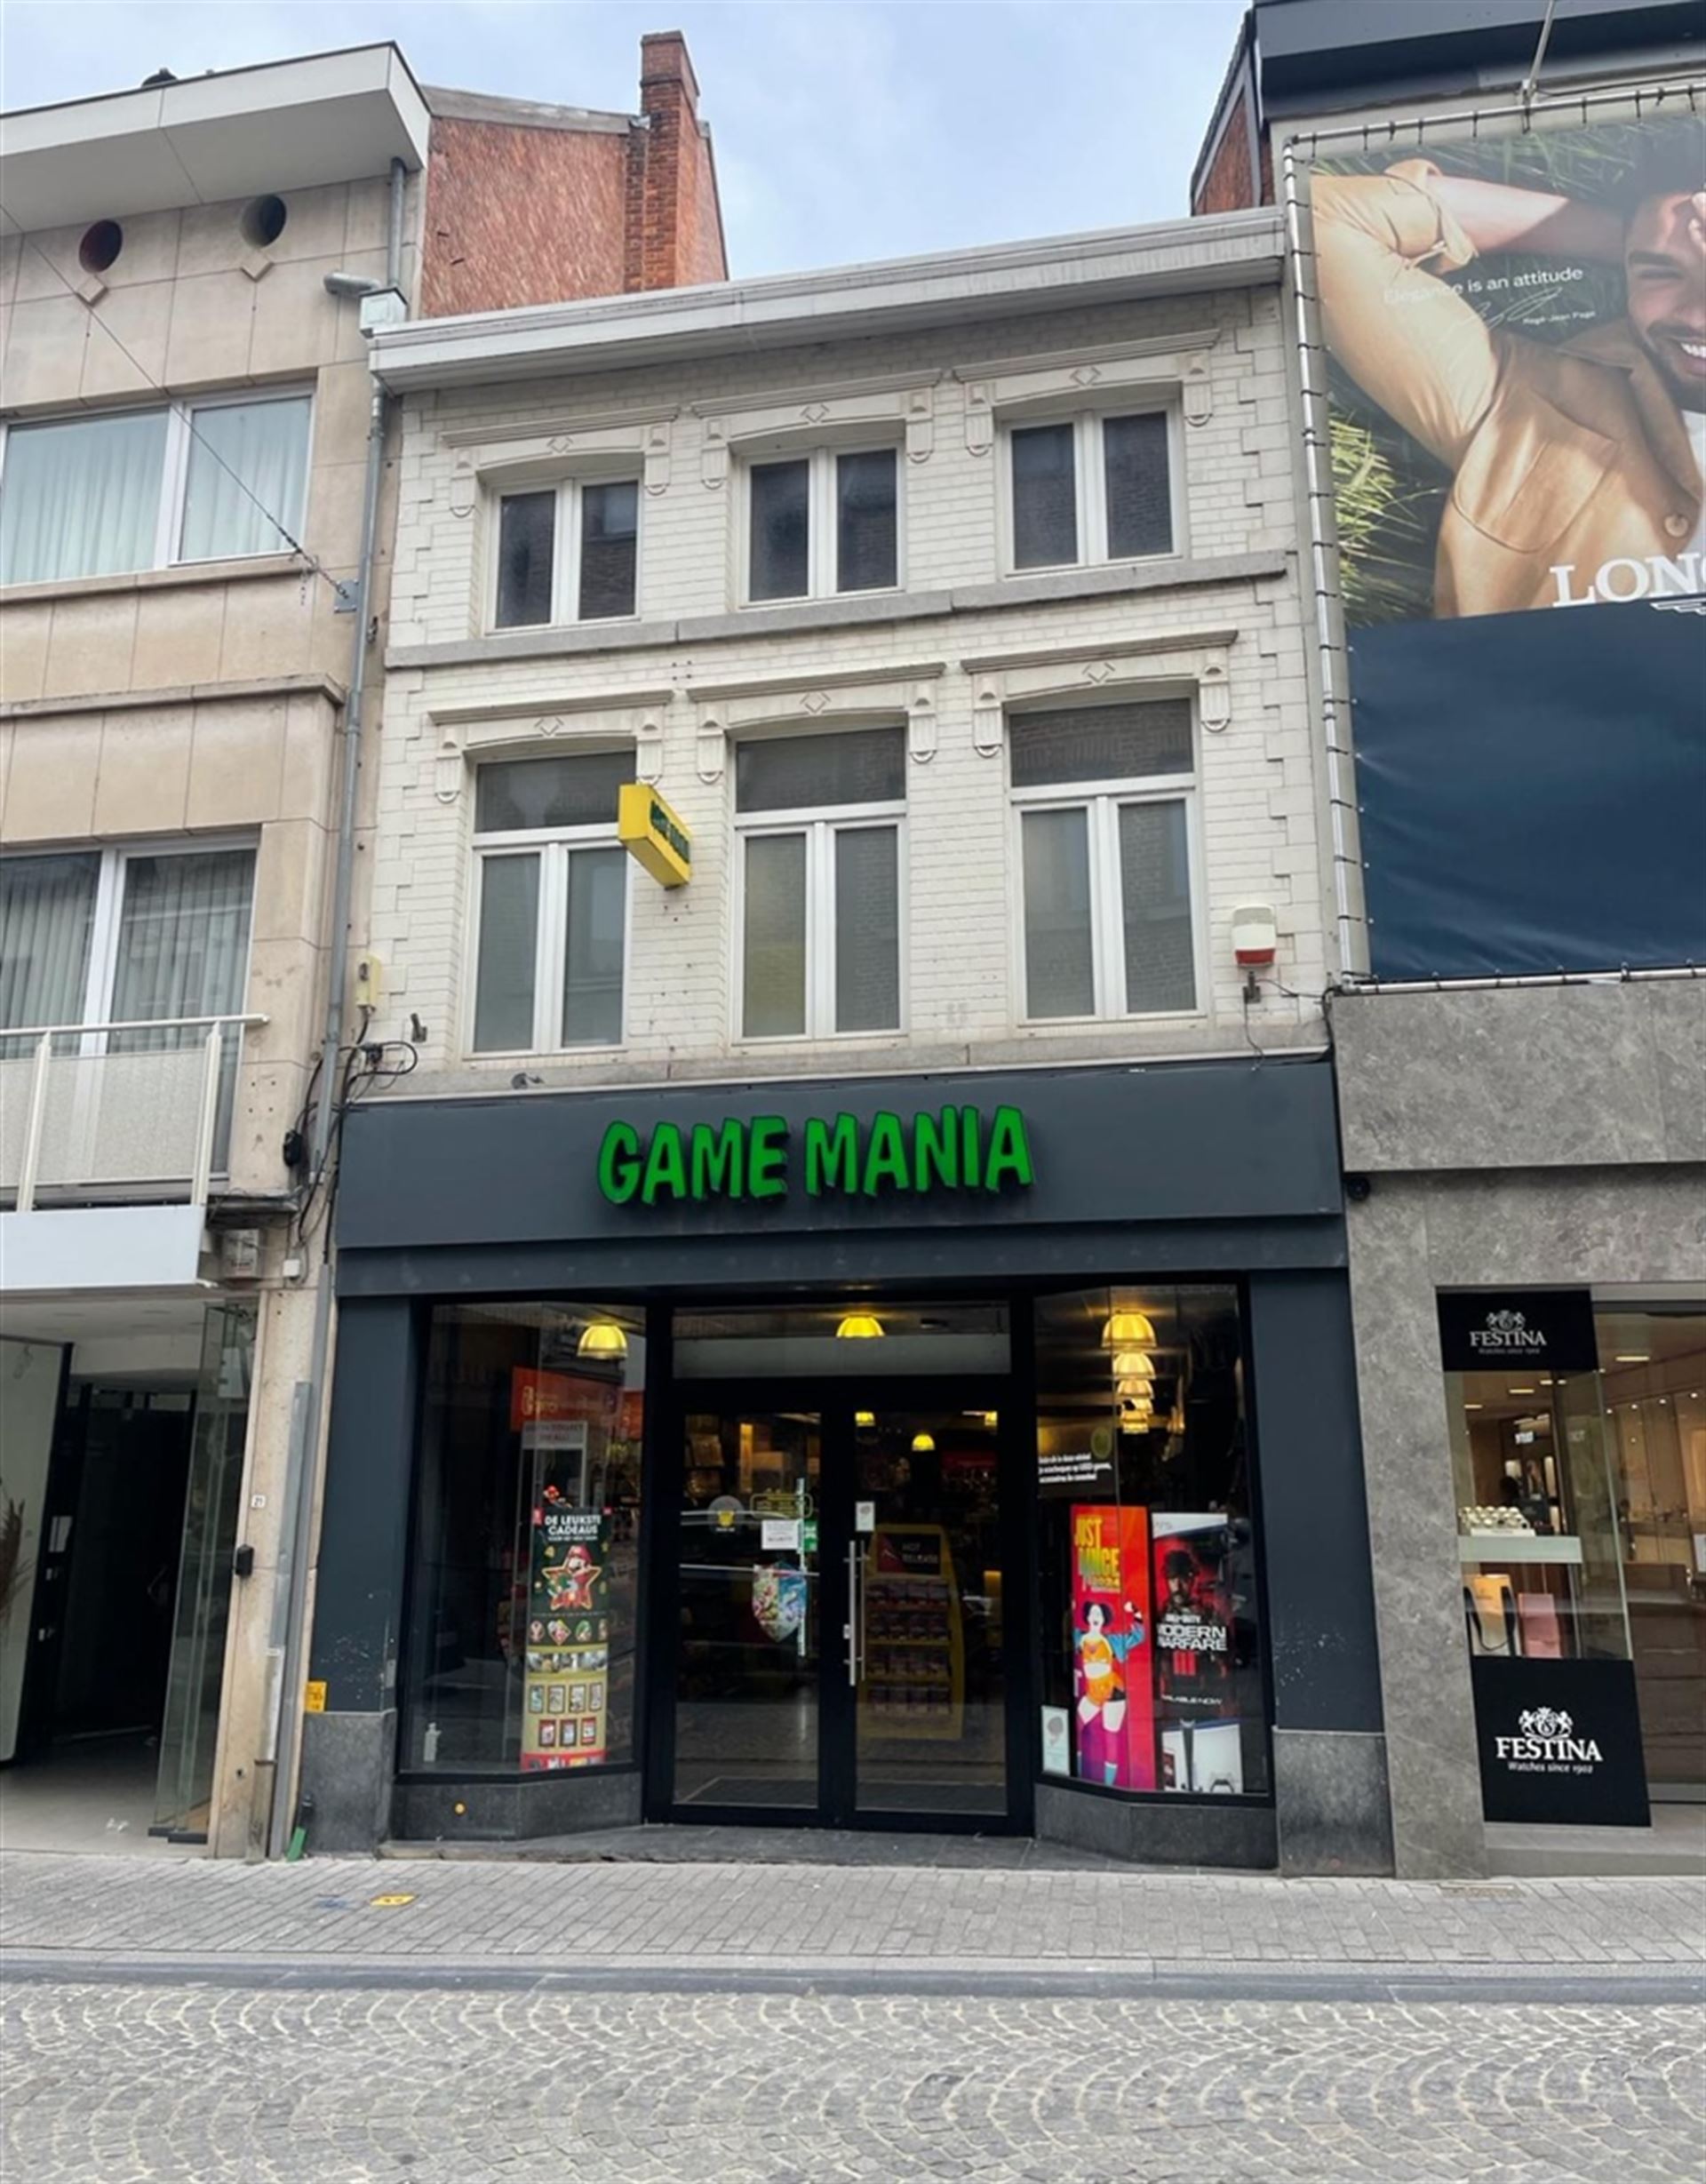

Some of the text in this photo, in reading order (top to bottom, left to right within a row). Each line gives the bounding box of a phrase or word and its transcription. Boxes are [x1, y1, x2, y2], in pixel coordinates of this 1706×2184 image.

[1468, 279, 1482, 293] is
[1487, 277, 1509, 291] an
[1513, 267, 1583, 289] attitude
[1550, 552, 1706, 608] LON
[597, 1104, 1033, 1205] GAME MANIA
[1469, 1330, 1547, 1347] FESTINA
[545, 1515, 558, 1526] DE
[547, 1525, 598, 1535] CADEAUS
[1495, 1736, 1603, 1762] FESTINA
[1508, 1761, 1545, 1773] Watches
[1547, 1763, 1570, 1773] since
